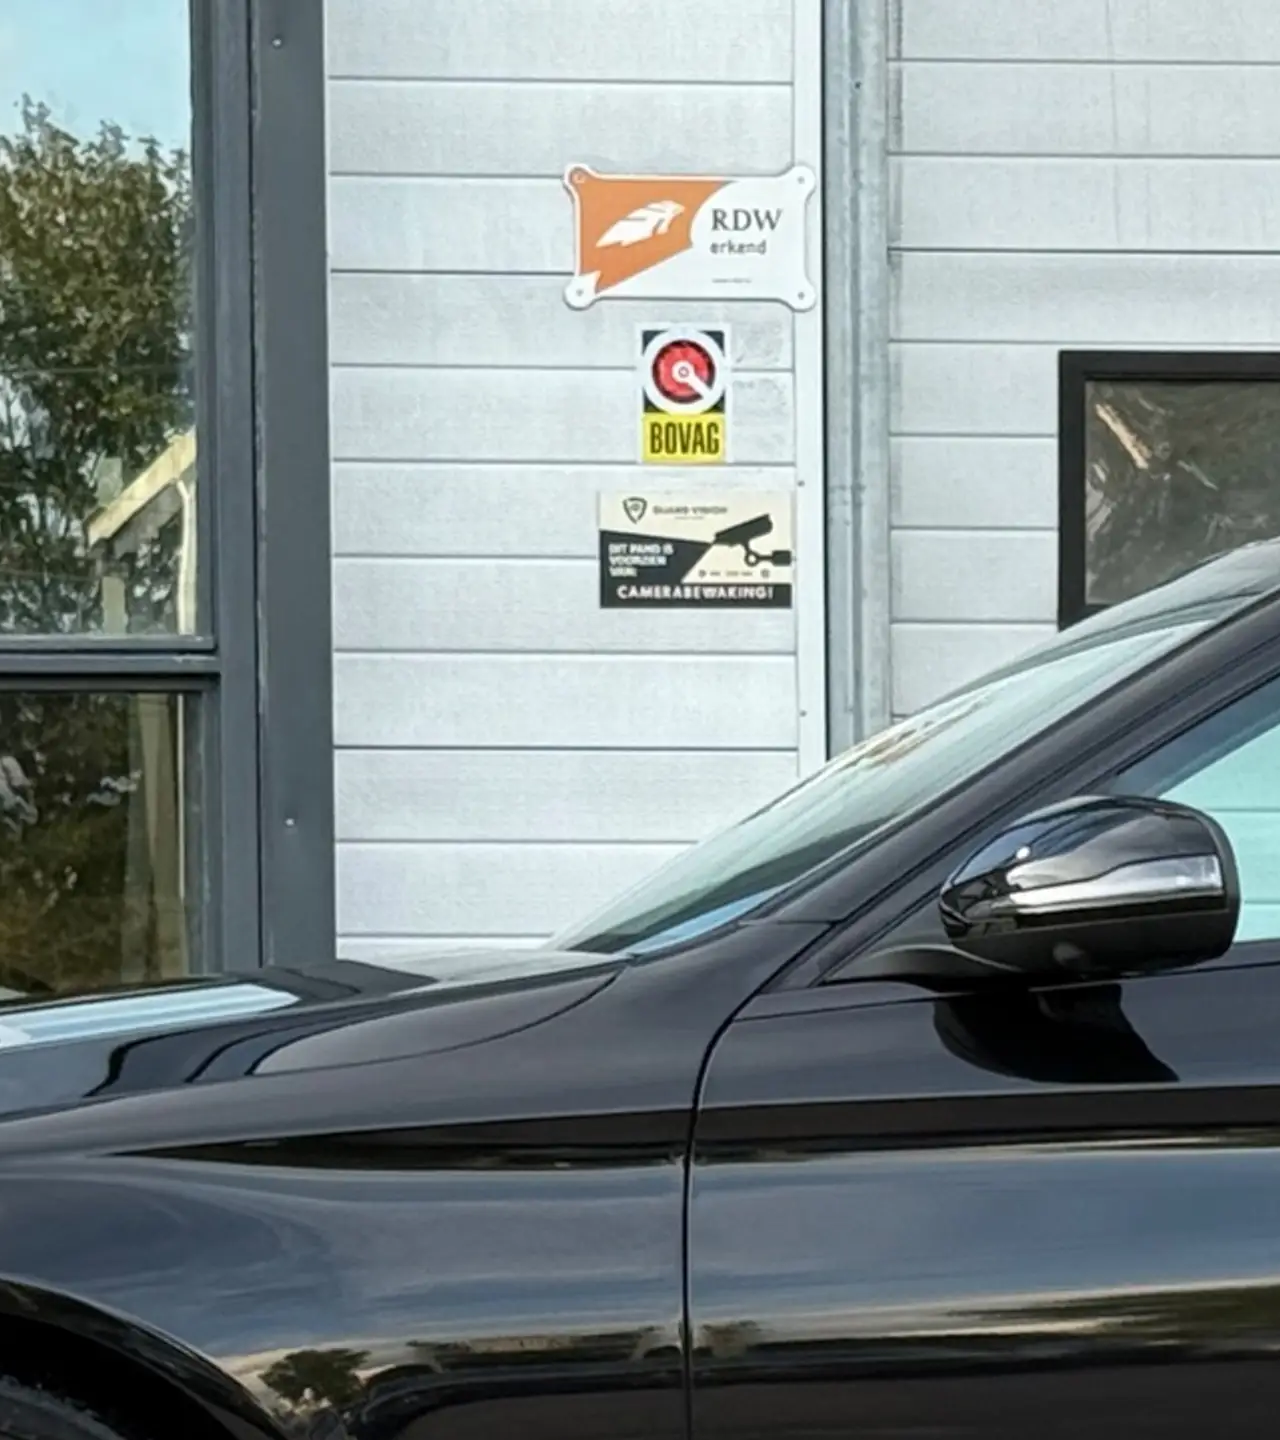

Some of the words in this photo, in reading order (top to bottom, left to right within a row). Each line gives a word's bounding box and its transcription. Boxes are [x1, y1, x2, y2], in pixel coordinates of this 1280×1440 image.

[711, 208, 782, 231] RDW
[710, 240, 767, 254] erkend
[650, 422, 720, 454] BOVAG
[616, 585, 773, 600] CAMERABEWAKING!
